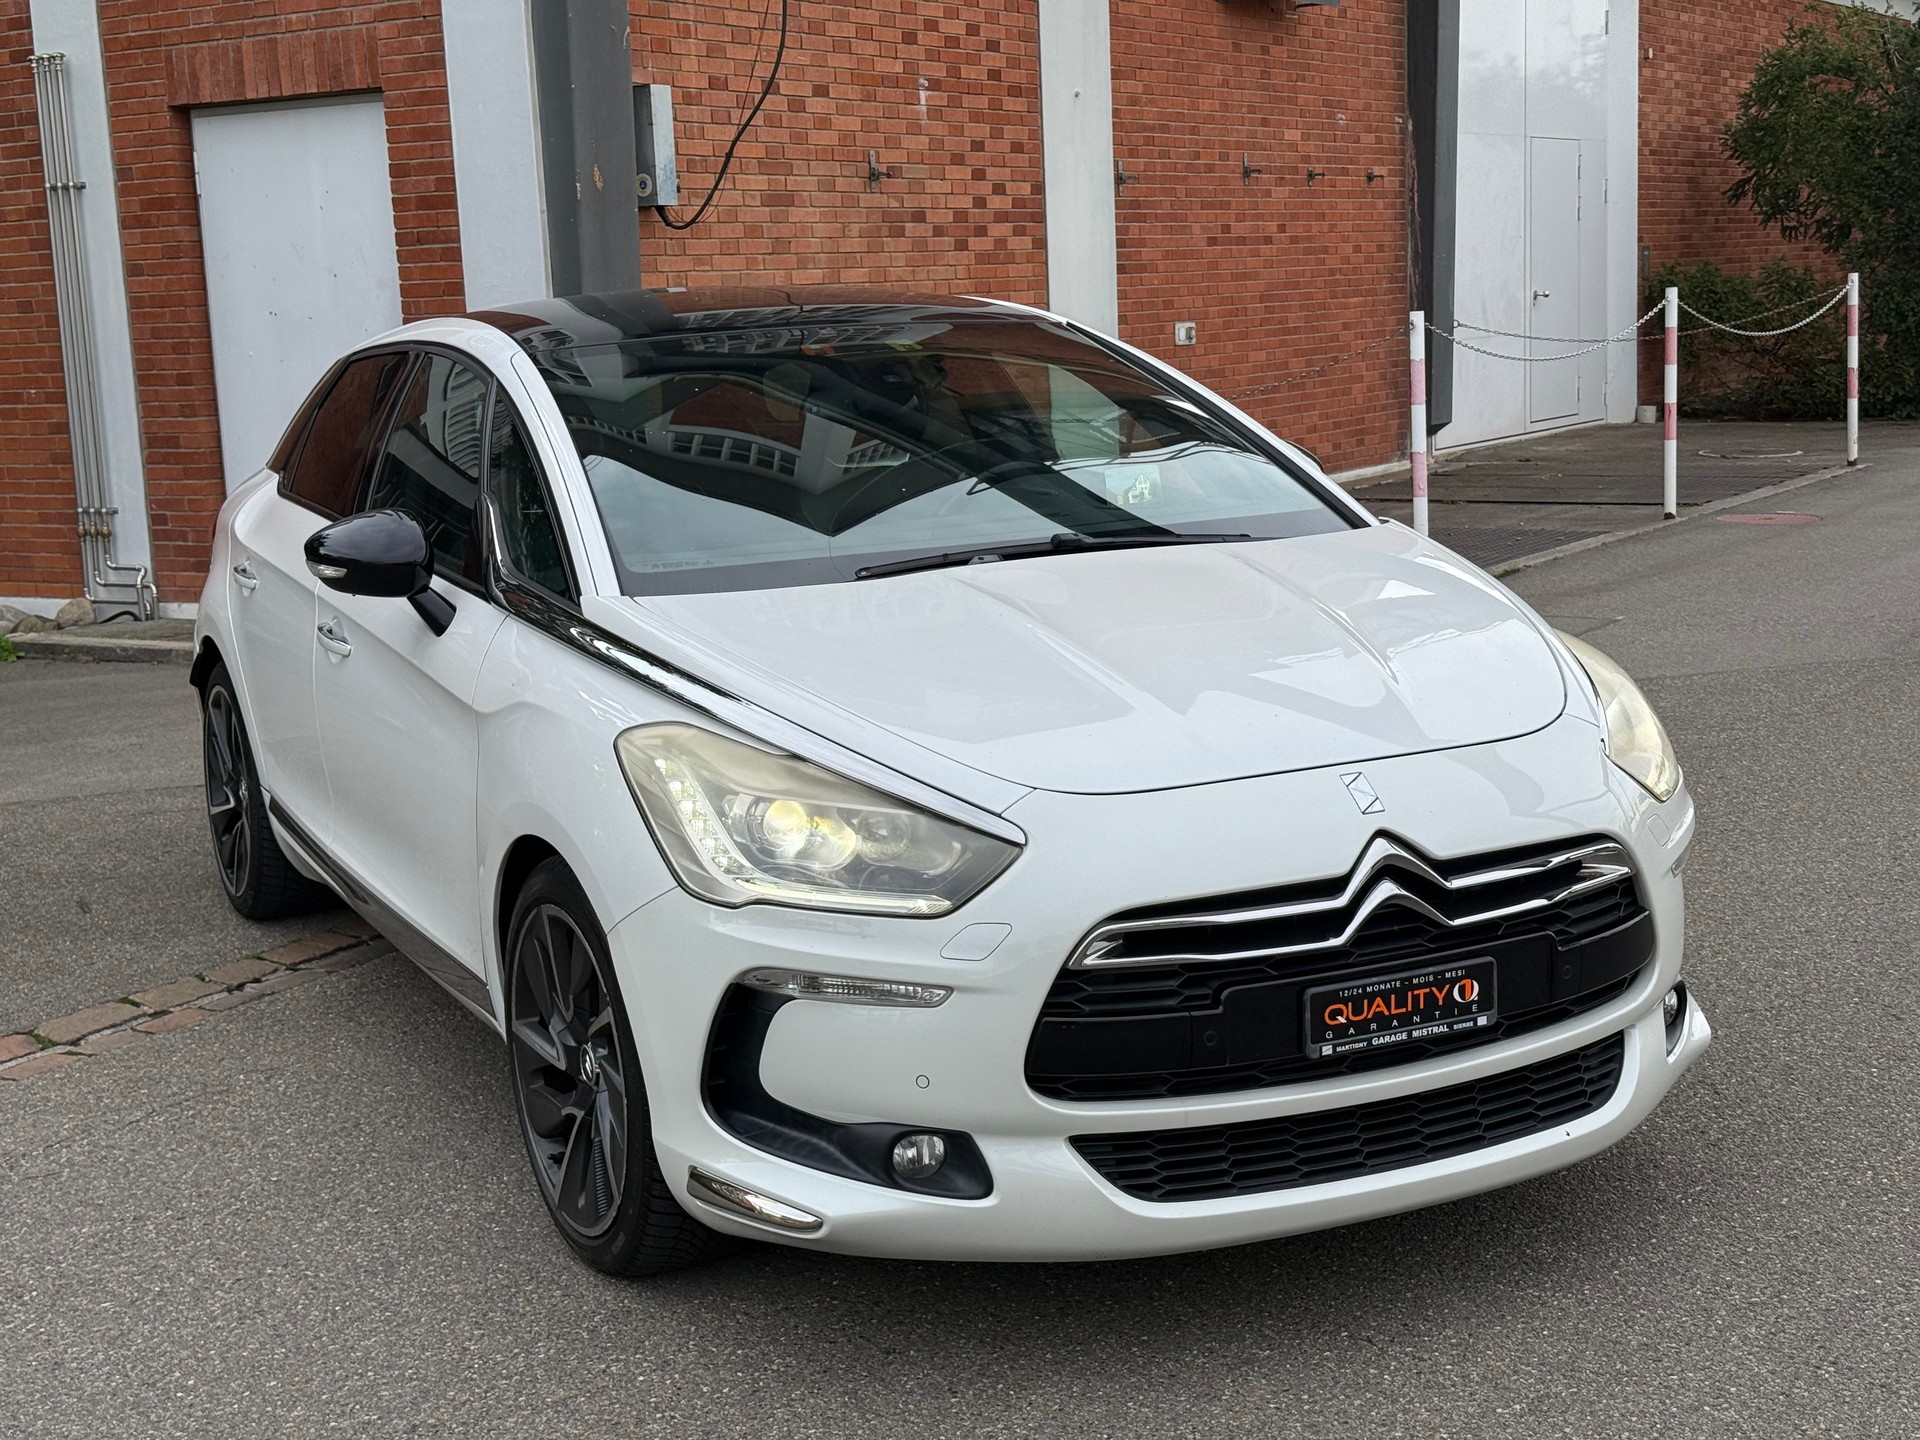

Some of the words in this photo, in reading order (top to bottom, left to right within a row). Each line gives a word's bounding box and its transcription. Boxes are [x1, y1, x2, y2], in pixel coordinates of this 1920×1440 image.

[1339, 987, 1363, 998] 12/24
[1366, 980, 1401, 993] MONATE
[1412, 975, 1434, 984] MOIS
[1445, 969, 1465, 979] MESI
[1324, 984, 1451, 1026] QUALITY
[1326, 1004, 1478, 1039] GARANTIE
[1336, 1042, 1367, 1052] MARTIGNY
[1371, 1032, 1408, 1046] GARAGE
[1412, 1024, 1449, 1037] MISTRAL
